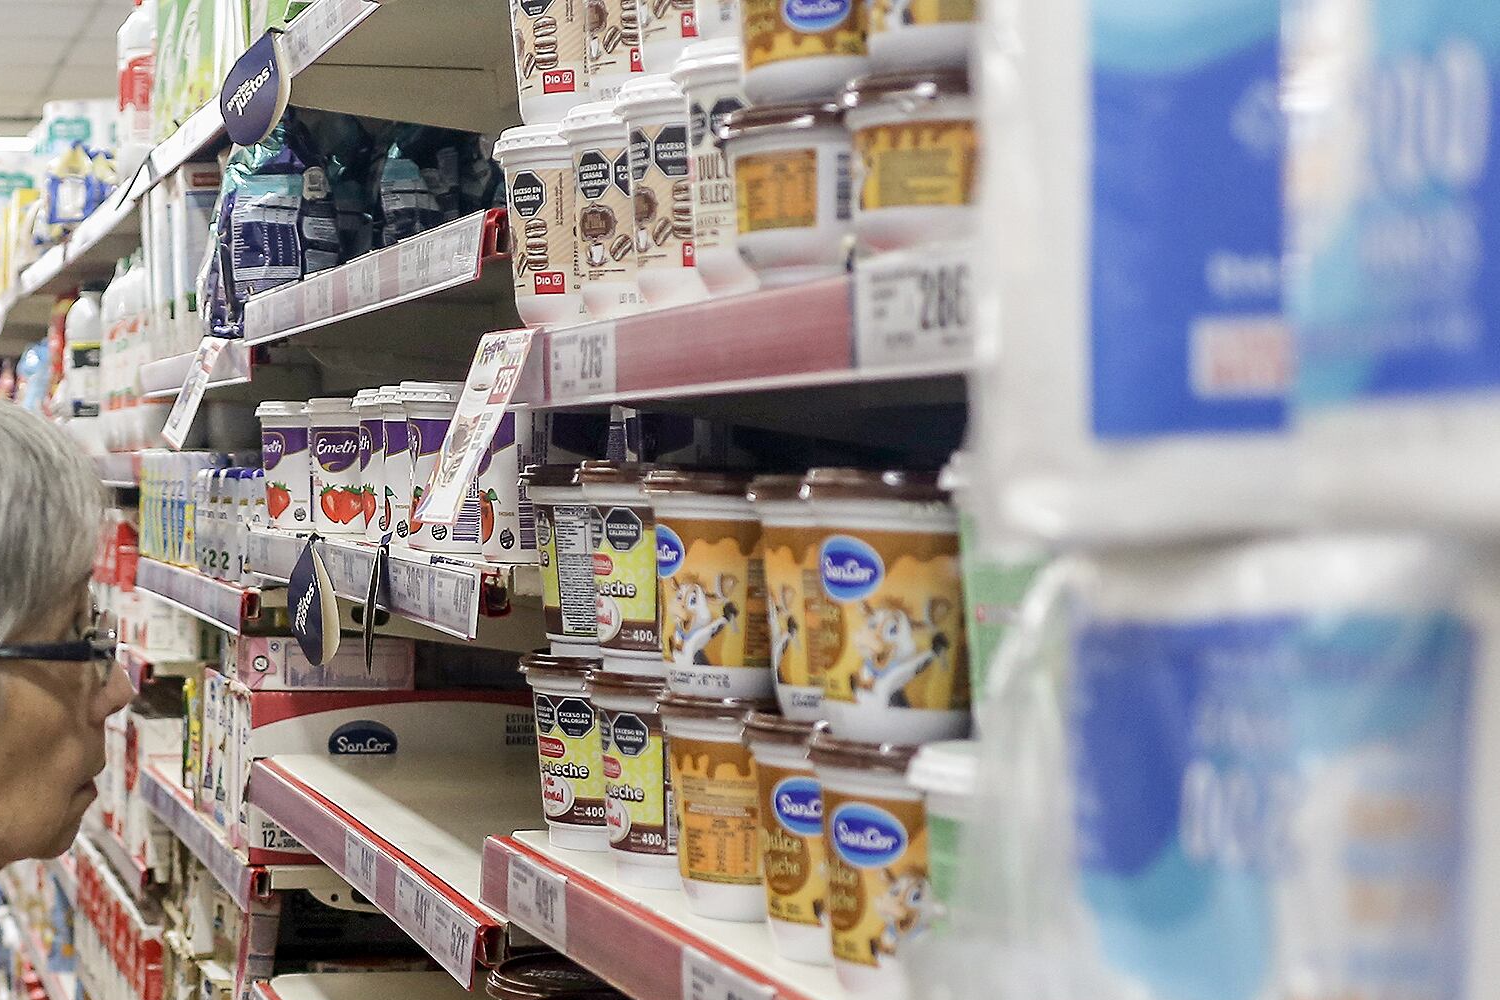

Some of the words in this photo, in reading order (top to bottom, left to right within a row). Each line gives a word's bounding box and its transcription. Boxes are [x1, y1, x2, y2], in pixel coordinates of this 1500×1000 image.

[235, 66, 270, 117] justos
[316, 438, 358, 455] Emeth
[632, 629, 653, 642] 400
[337, 736, 391, 753] SanCor
[548, 762, 589, 778] Leche
[585, 806, 606, 818] 400
[262, 830, 278, 849] 12
[641, 833, 661, 845] 400
[838, 821, 899, 851] SanCor
